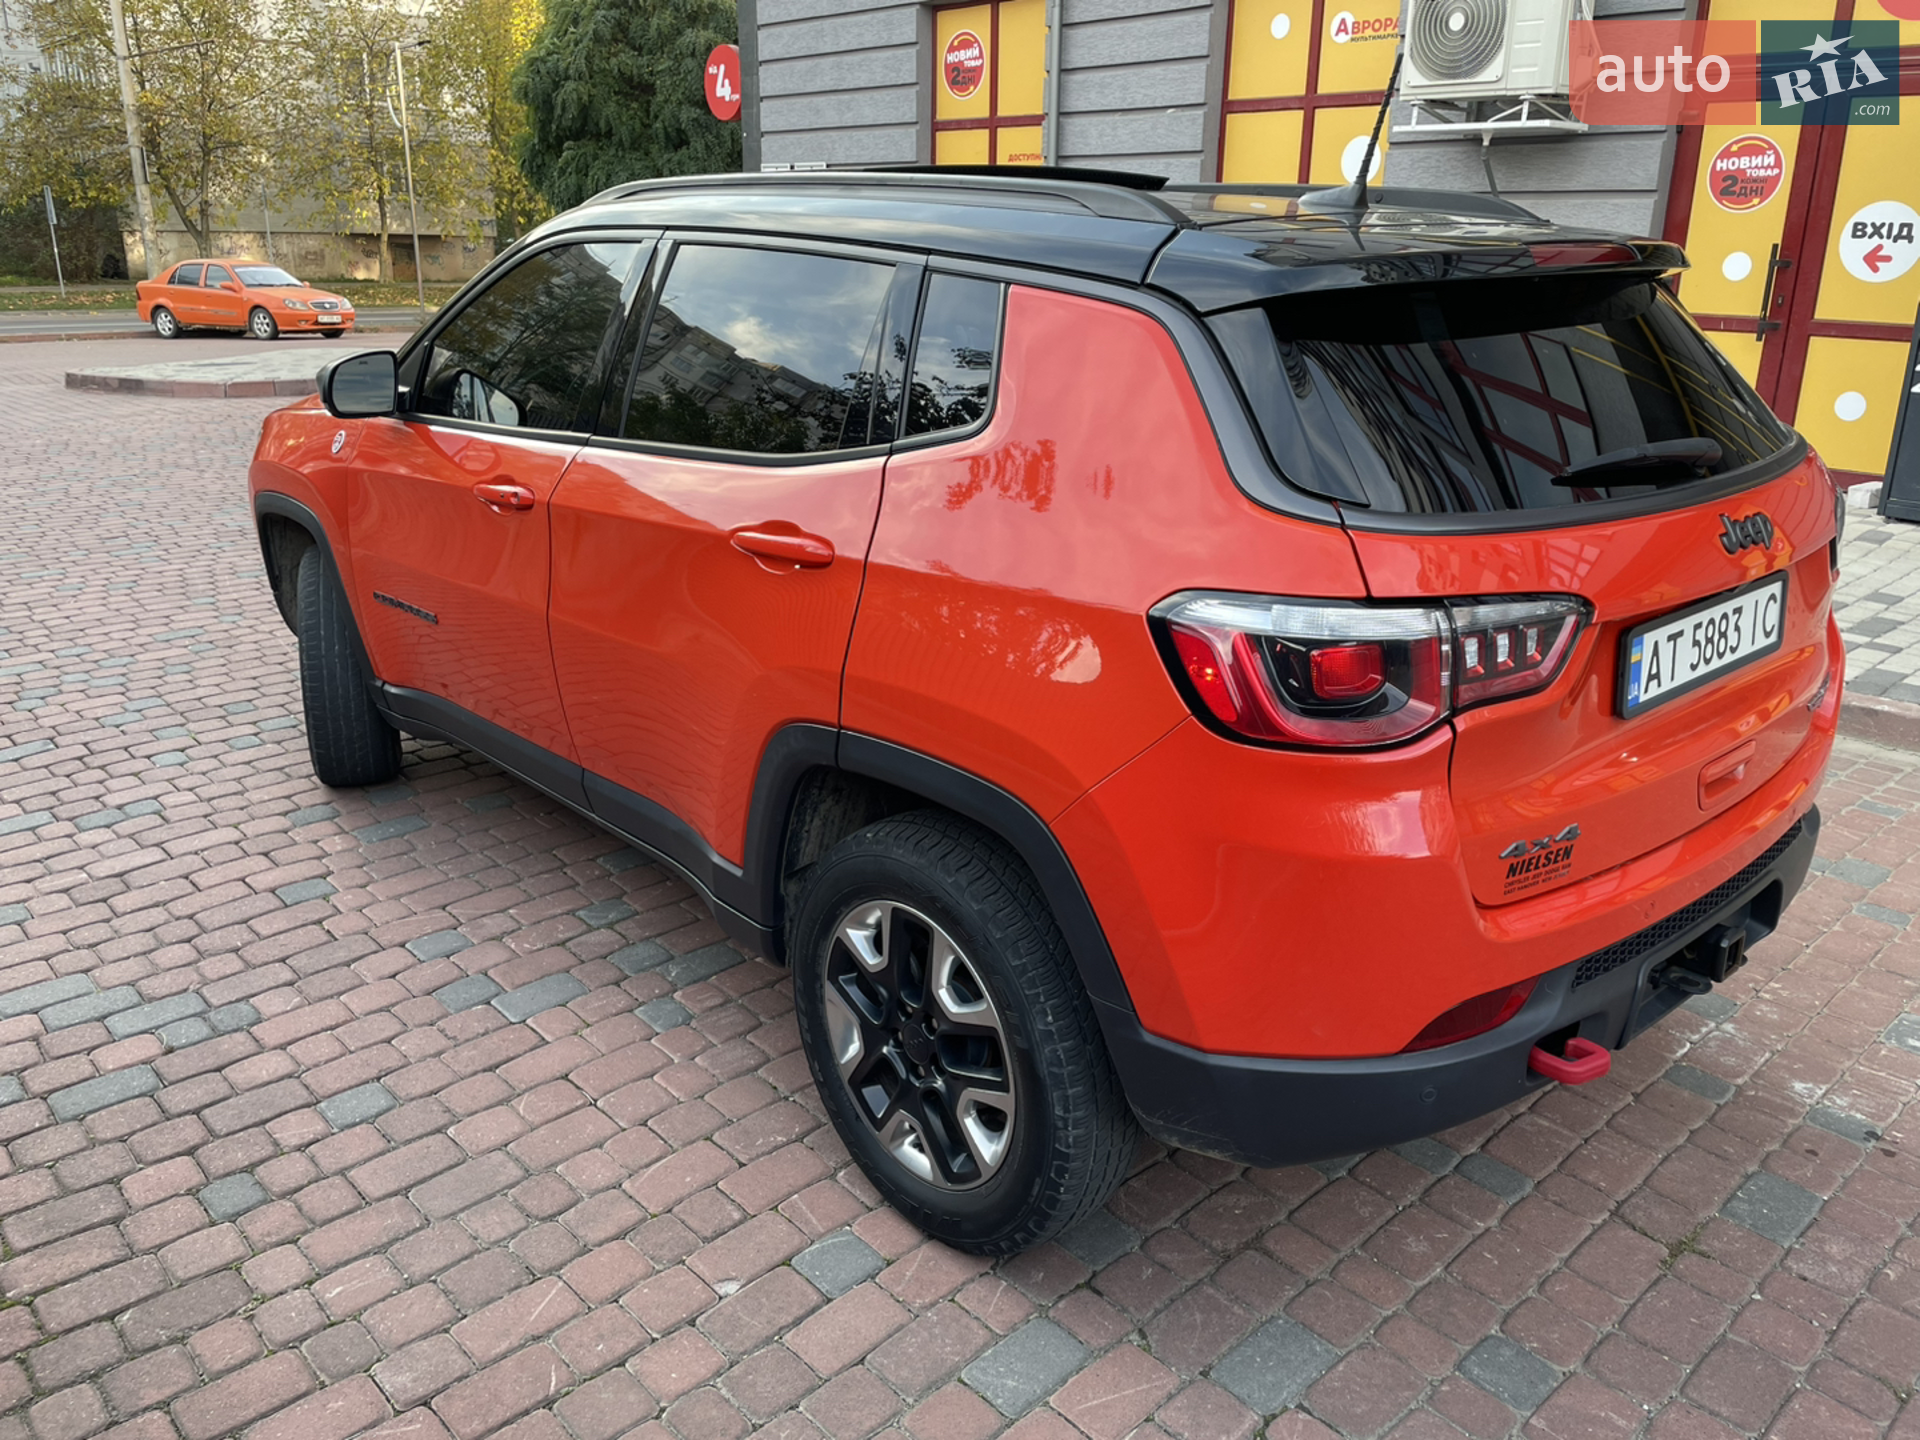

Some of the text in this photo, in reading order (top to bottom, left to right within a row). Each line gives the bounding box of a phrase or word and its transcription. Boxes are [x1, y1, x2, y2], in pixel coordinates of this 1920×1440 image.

[947, 43, 980, 64] НОВИЙ
[964, 58, 983, 68] ТОВАР
[715, 63, 732, 102] 4
[951, 66, 961, 86] 2
[960, 74, 976, 87] ДНІ
[1715, 149, 1775, 172] НОВИЙ
[1745, 168, 1780, 177] ТОВАР
[1719, 174, 1739, 197] 2
[1736, 185, 1765, 199] ДНІ
[1851, 221, 1914, 244] ВХІД
[1718, 511, 1774, 555] Jeep
[1643, 592, 1778, 695] AT 5883 IC
[1498, 822, 1581, 859] 4x4
[1505, 844, 1574, 880] NIELSEN
